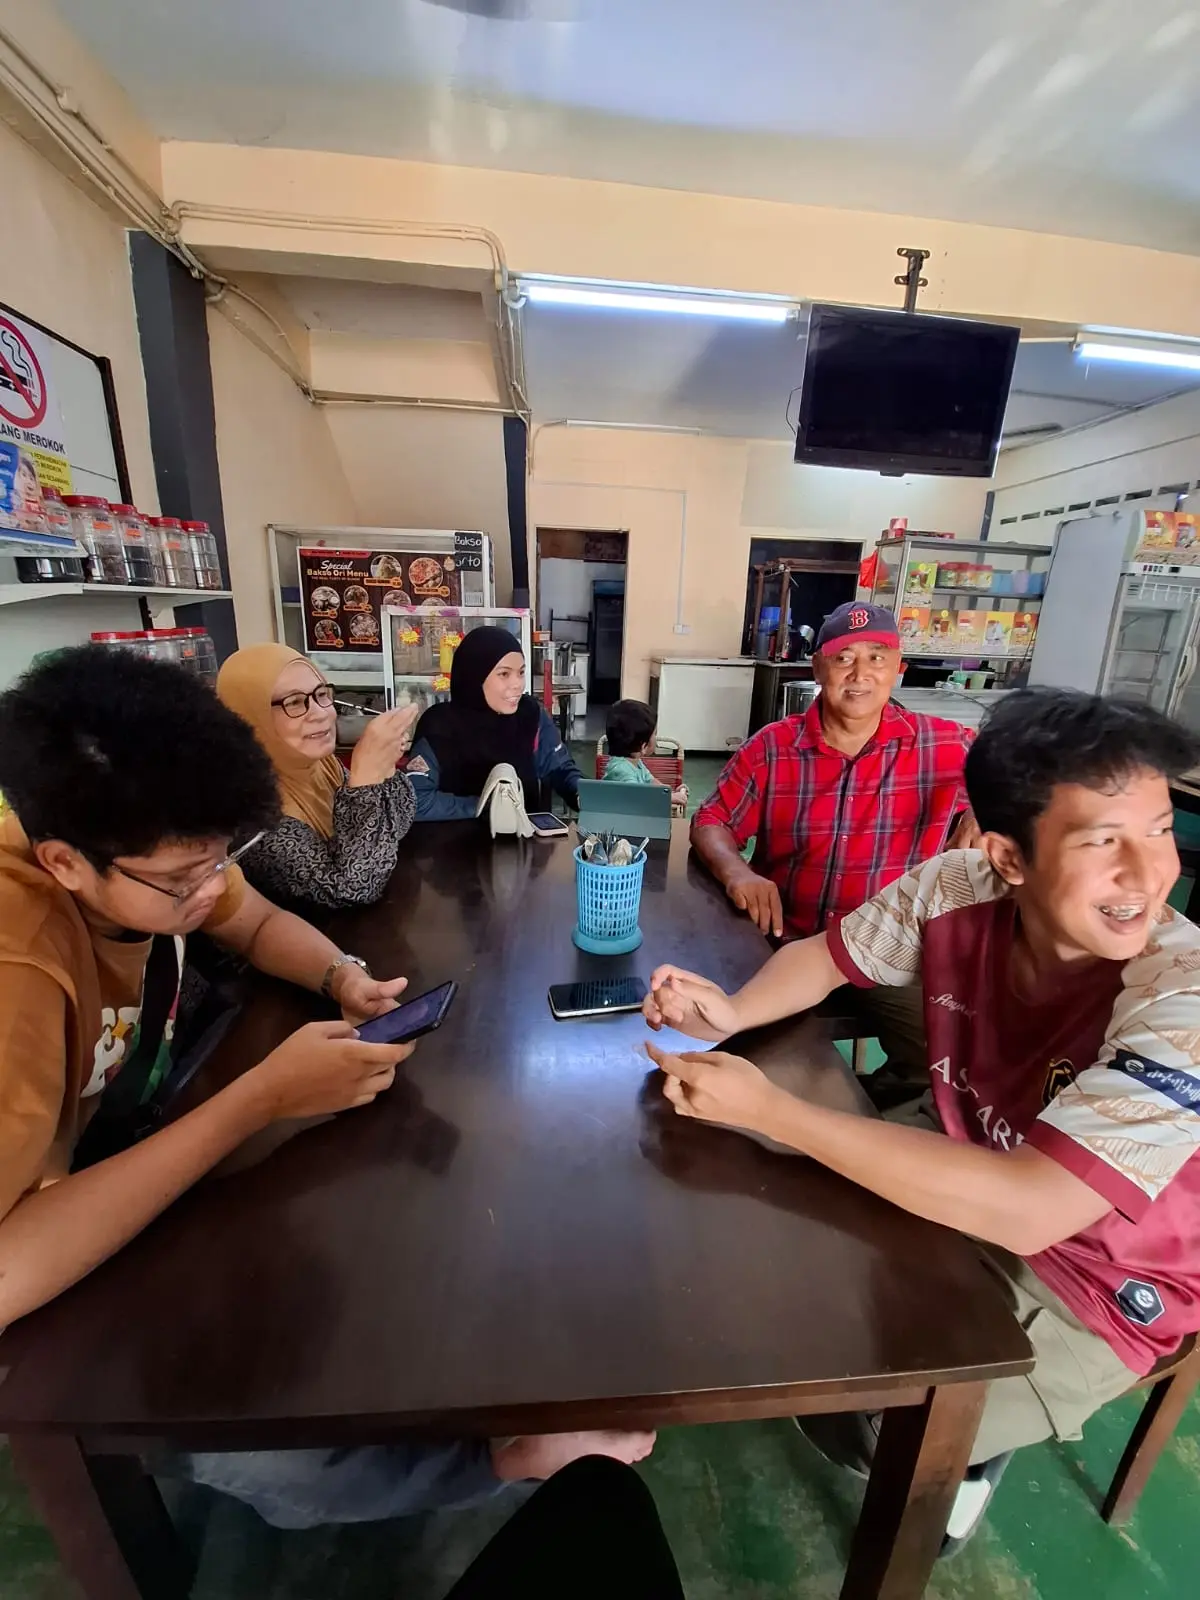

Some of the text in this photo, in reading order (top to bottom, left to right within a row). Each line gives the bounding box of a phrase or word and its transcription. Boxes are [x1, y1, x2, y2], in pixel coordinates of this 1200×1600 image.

[0, 423, 66, 454] ANG MEROKOK
[307, 568, 332, 576] Bakso
[333, 569, 346, 577] Ori
[320, 560, 354, 573] Special
[848, 608, 869, 630] B
